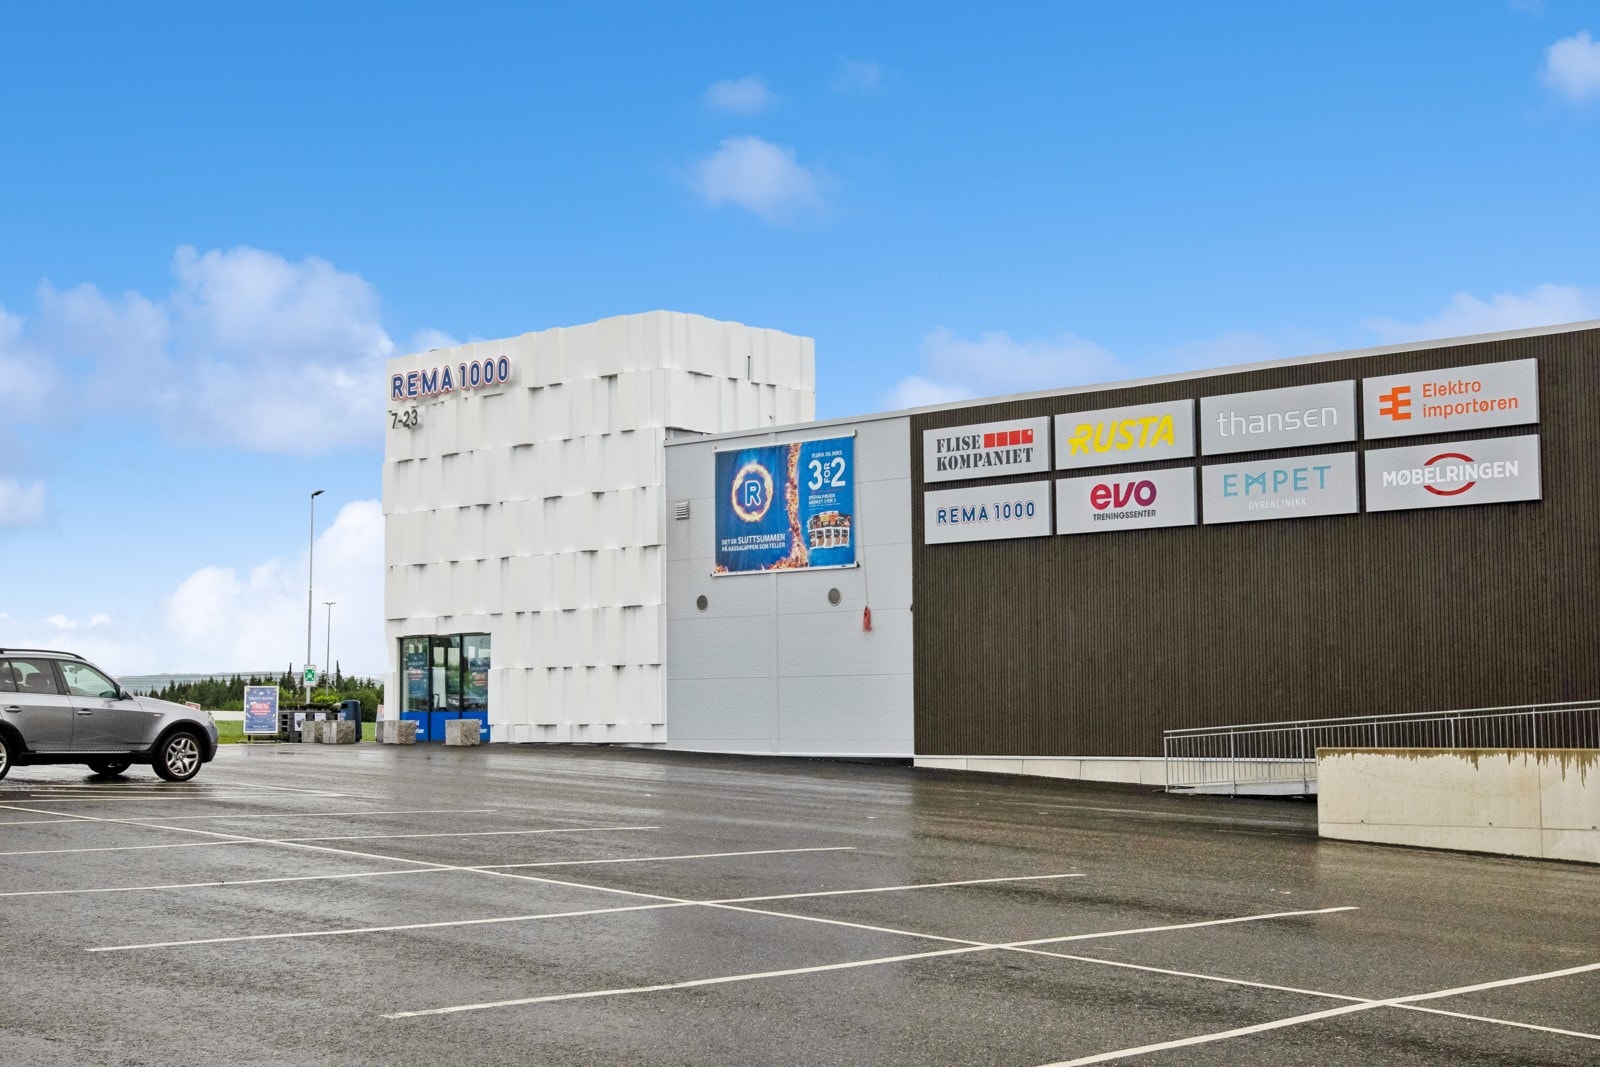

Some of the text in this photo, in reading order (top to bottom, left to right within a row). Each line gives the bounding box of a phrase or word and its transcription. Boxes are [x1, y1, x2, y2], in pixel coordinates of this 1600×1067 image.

[391, 355, 510, 400] REMA 1000
[1422, 379, 1482, 397] Elektro
[391, 409, 418, 429] 7-23
[1422, 396, 1519, 420] importøren
[1216, 406, 1338, 437] thansen
[936, 434, 981, 453] FLISE
[1067, 414, 1175, 456] RUSTA
[936, 447, 1034, 472] KOMPANIET
[808, 460, 822, 490] 3
[831, 457, 846, 487] 2
[1223, 465, 1332, 497] EMPET
[1382, 459, 1519, 487] MØBELRINGEN
[745, 480, 761, 506] R
[1090, 480, 1157, 510] evo
[1248, 497, 1307, 510] DYREKLINIKK
[937, 500, 1036, 526] REMA 1000
[1092, 509, 1157, 521] TRENINGSSENTER
[738, 533, 786, 544] SLUTTSUMMEN
